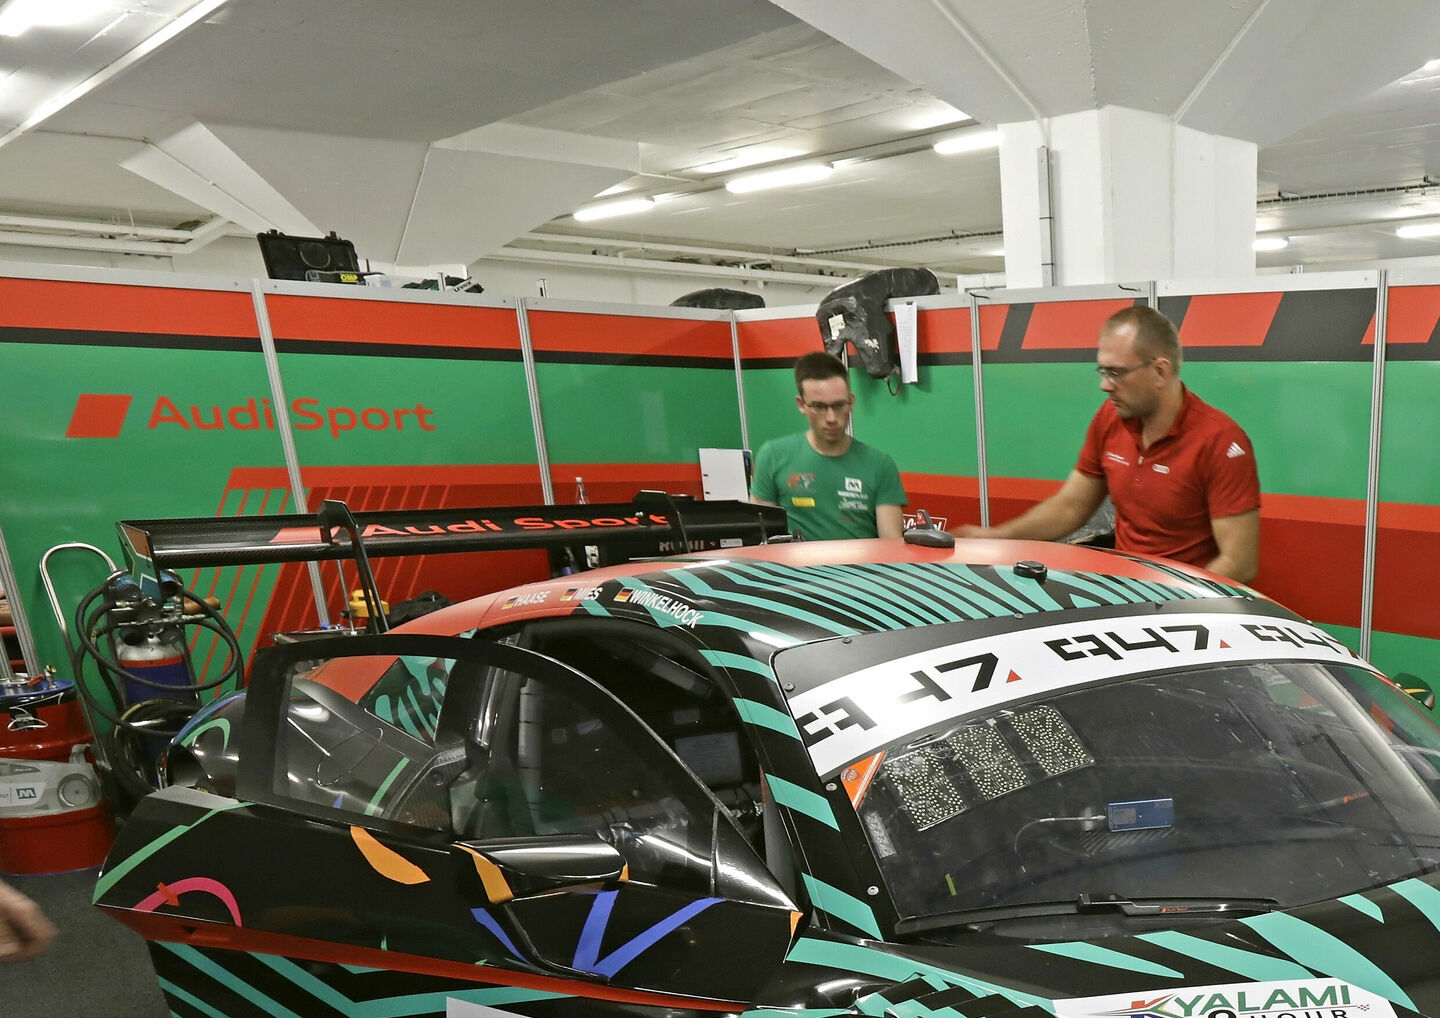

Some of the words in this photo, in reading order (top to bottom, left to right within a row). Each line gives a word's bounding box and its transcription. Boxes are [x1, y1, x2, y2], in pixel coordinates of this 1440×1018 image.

[147, 395, 276, 430] Audi
[291, 397, 436, 438] Sport
[361, 519, 503, 538] Audi
[513, 514, 669, 531] Sport
[515, 590, 550, 607] HAASE
[573, 587, 603, 601] MIES
[629, 588, 704, 629] WINKELHOCK
[1043, 624, 1210, 662] 947
